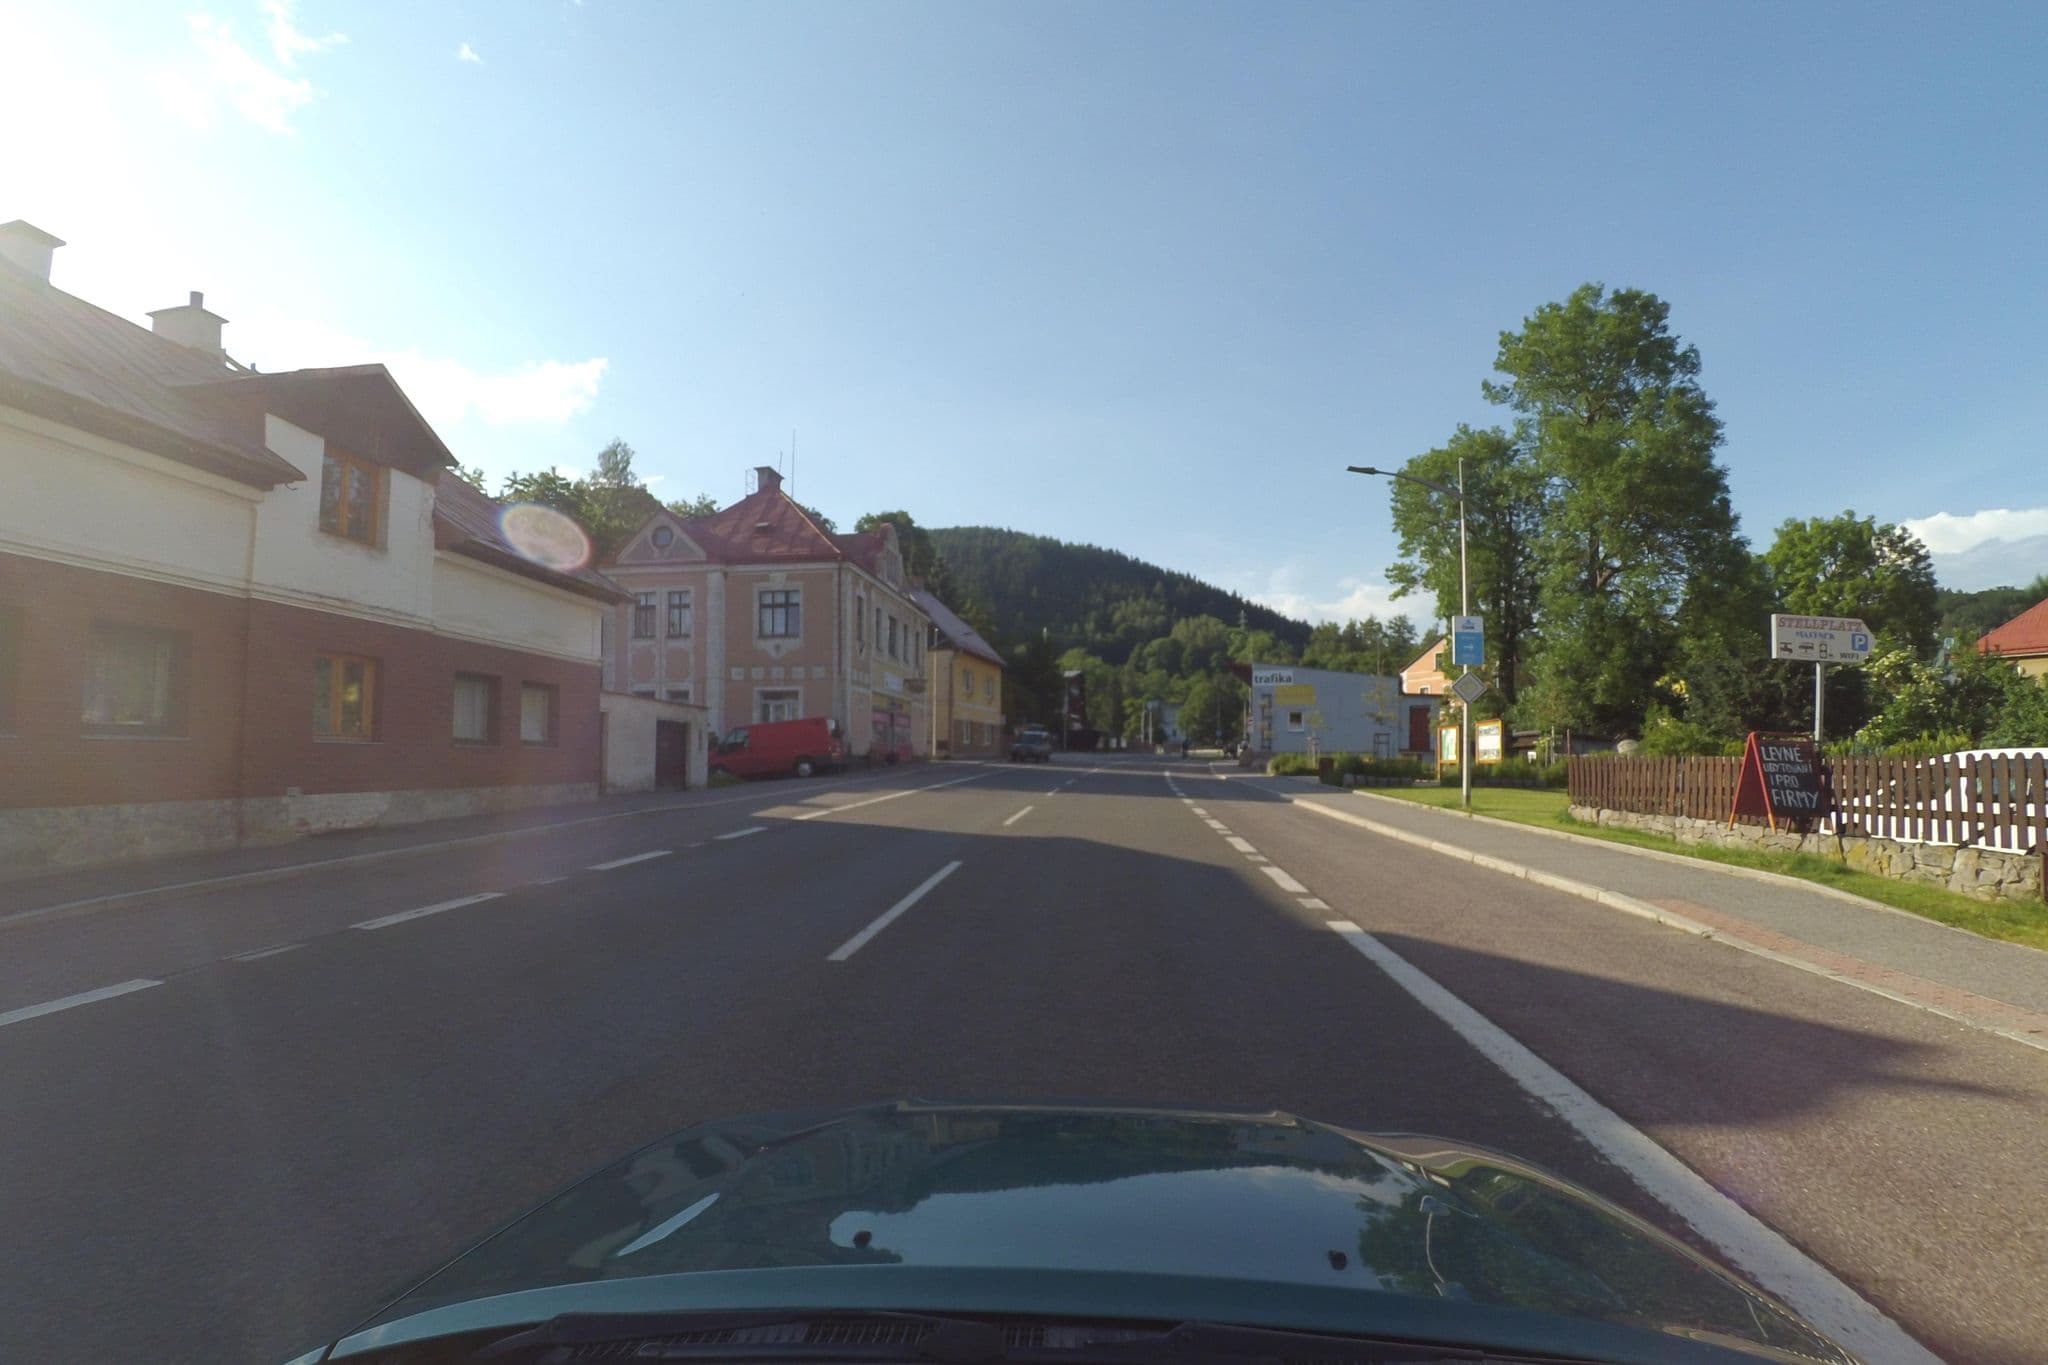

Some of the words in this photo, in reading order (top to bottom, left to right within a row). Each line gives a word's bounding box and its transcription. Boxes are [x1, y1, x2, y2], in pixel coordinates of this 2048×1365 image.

[1778, 616, 1863, 632] STELLPLATZ
[1255, 672, 1292, 684] trafika
[1776, 774, 1799, 788] PRO
[1772, 789, 1819, 809] FIRMY
